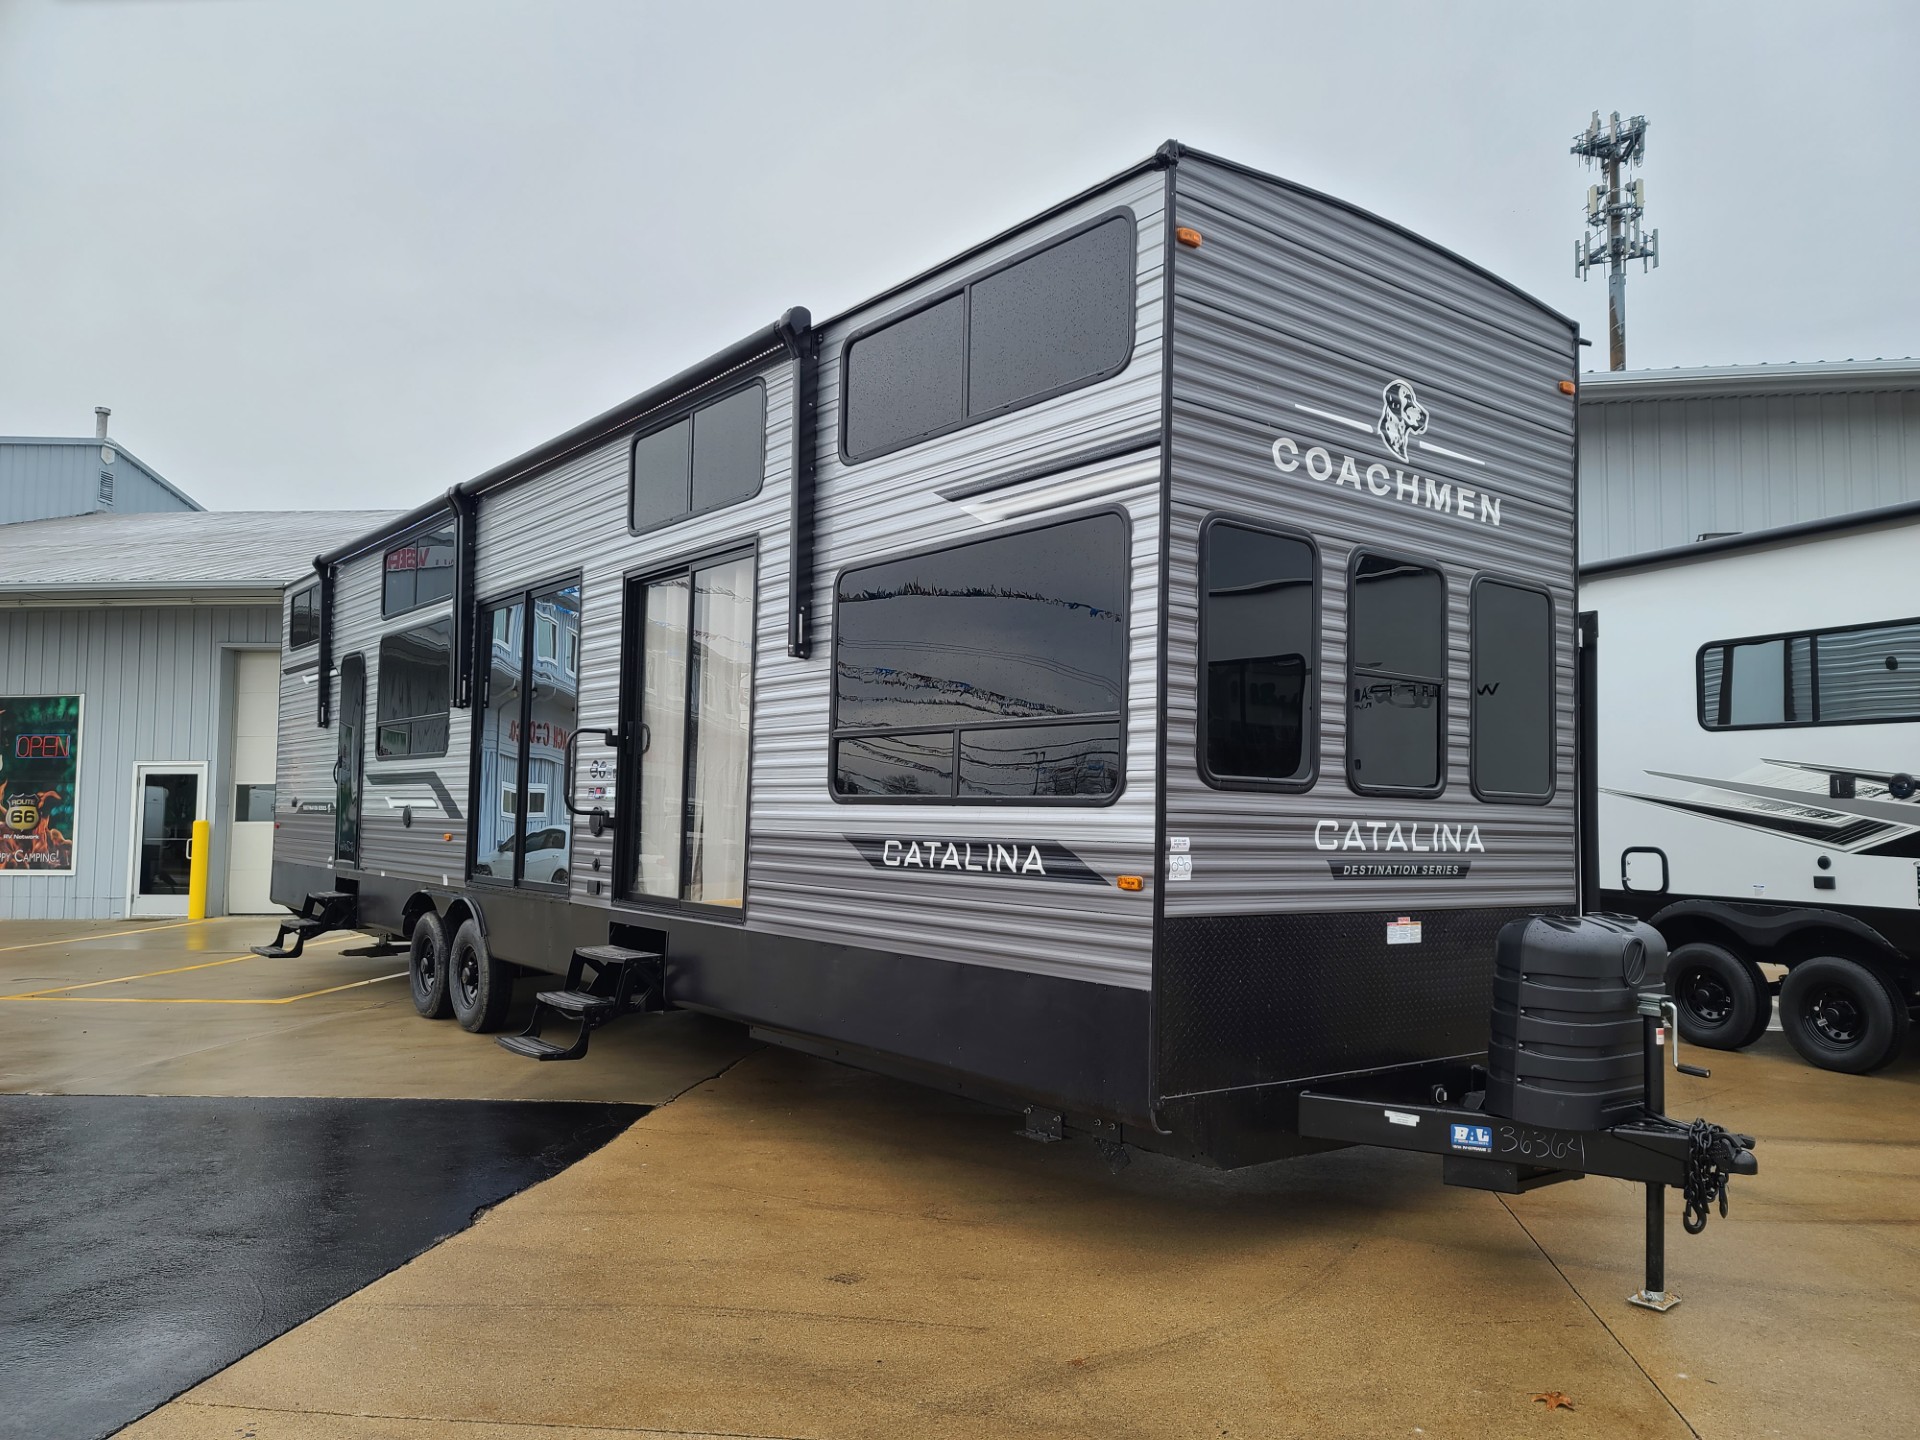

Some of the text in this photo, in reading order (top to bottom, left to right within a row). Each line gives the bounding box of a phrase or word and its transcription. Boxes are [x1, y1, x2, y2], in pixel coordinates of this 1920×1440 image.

[1271, 437, 1501, 526] COACHMEN
[17, 736, 69, 757] OPEN
[11, 810, 35, 823] 66
[1314, 820, 1486, 853] CATALINA
[882, 840, 1047, 875] CATALINA
[1343, 865, 1459, 876] DESTINATION SERIES
